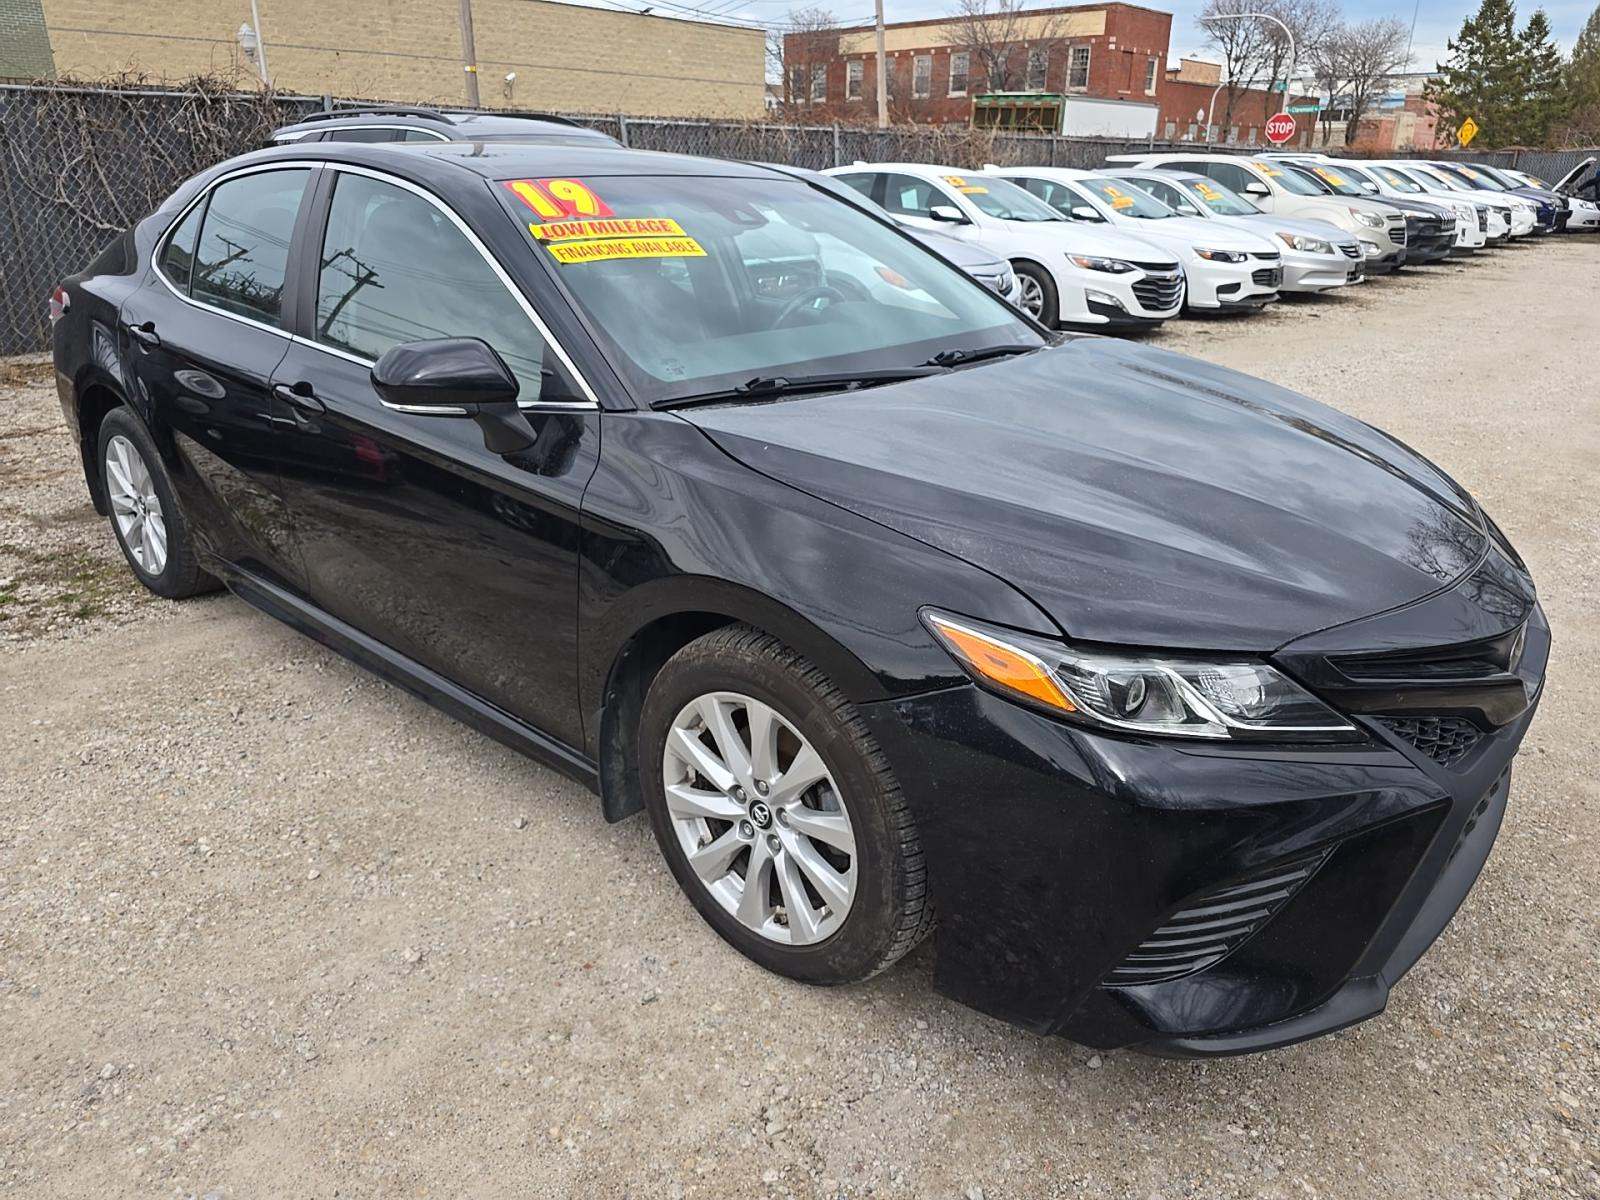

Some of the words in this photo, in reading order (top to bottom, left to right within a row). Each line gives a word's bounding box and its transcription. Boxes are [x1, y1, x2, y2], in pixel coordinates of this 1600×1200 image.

[1268, 122, 1293, 134] STOP
[511, 180, 600, 217] 19
[540, 222, 585, 238] LOW
[589, 219, 673, 234] MILEAGE
[556, 242, 632, 260] FINANCING
[631, 240, 697, 255] AVAILABLE
